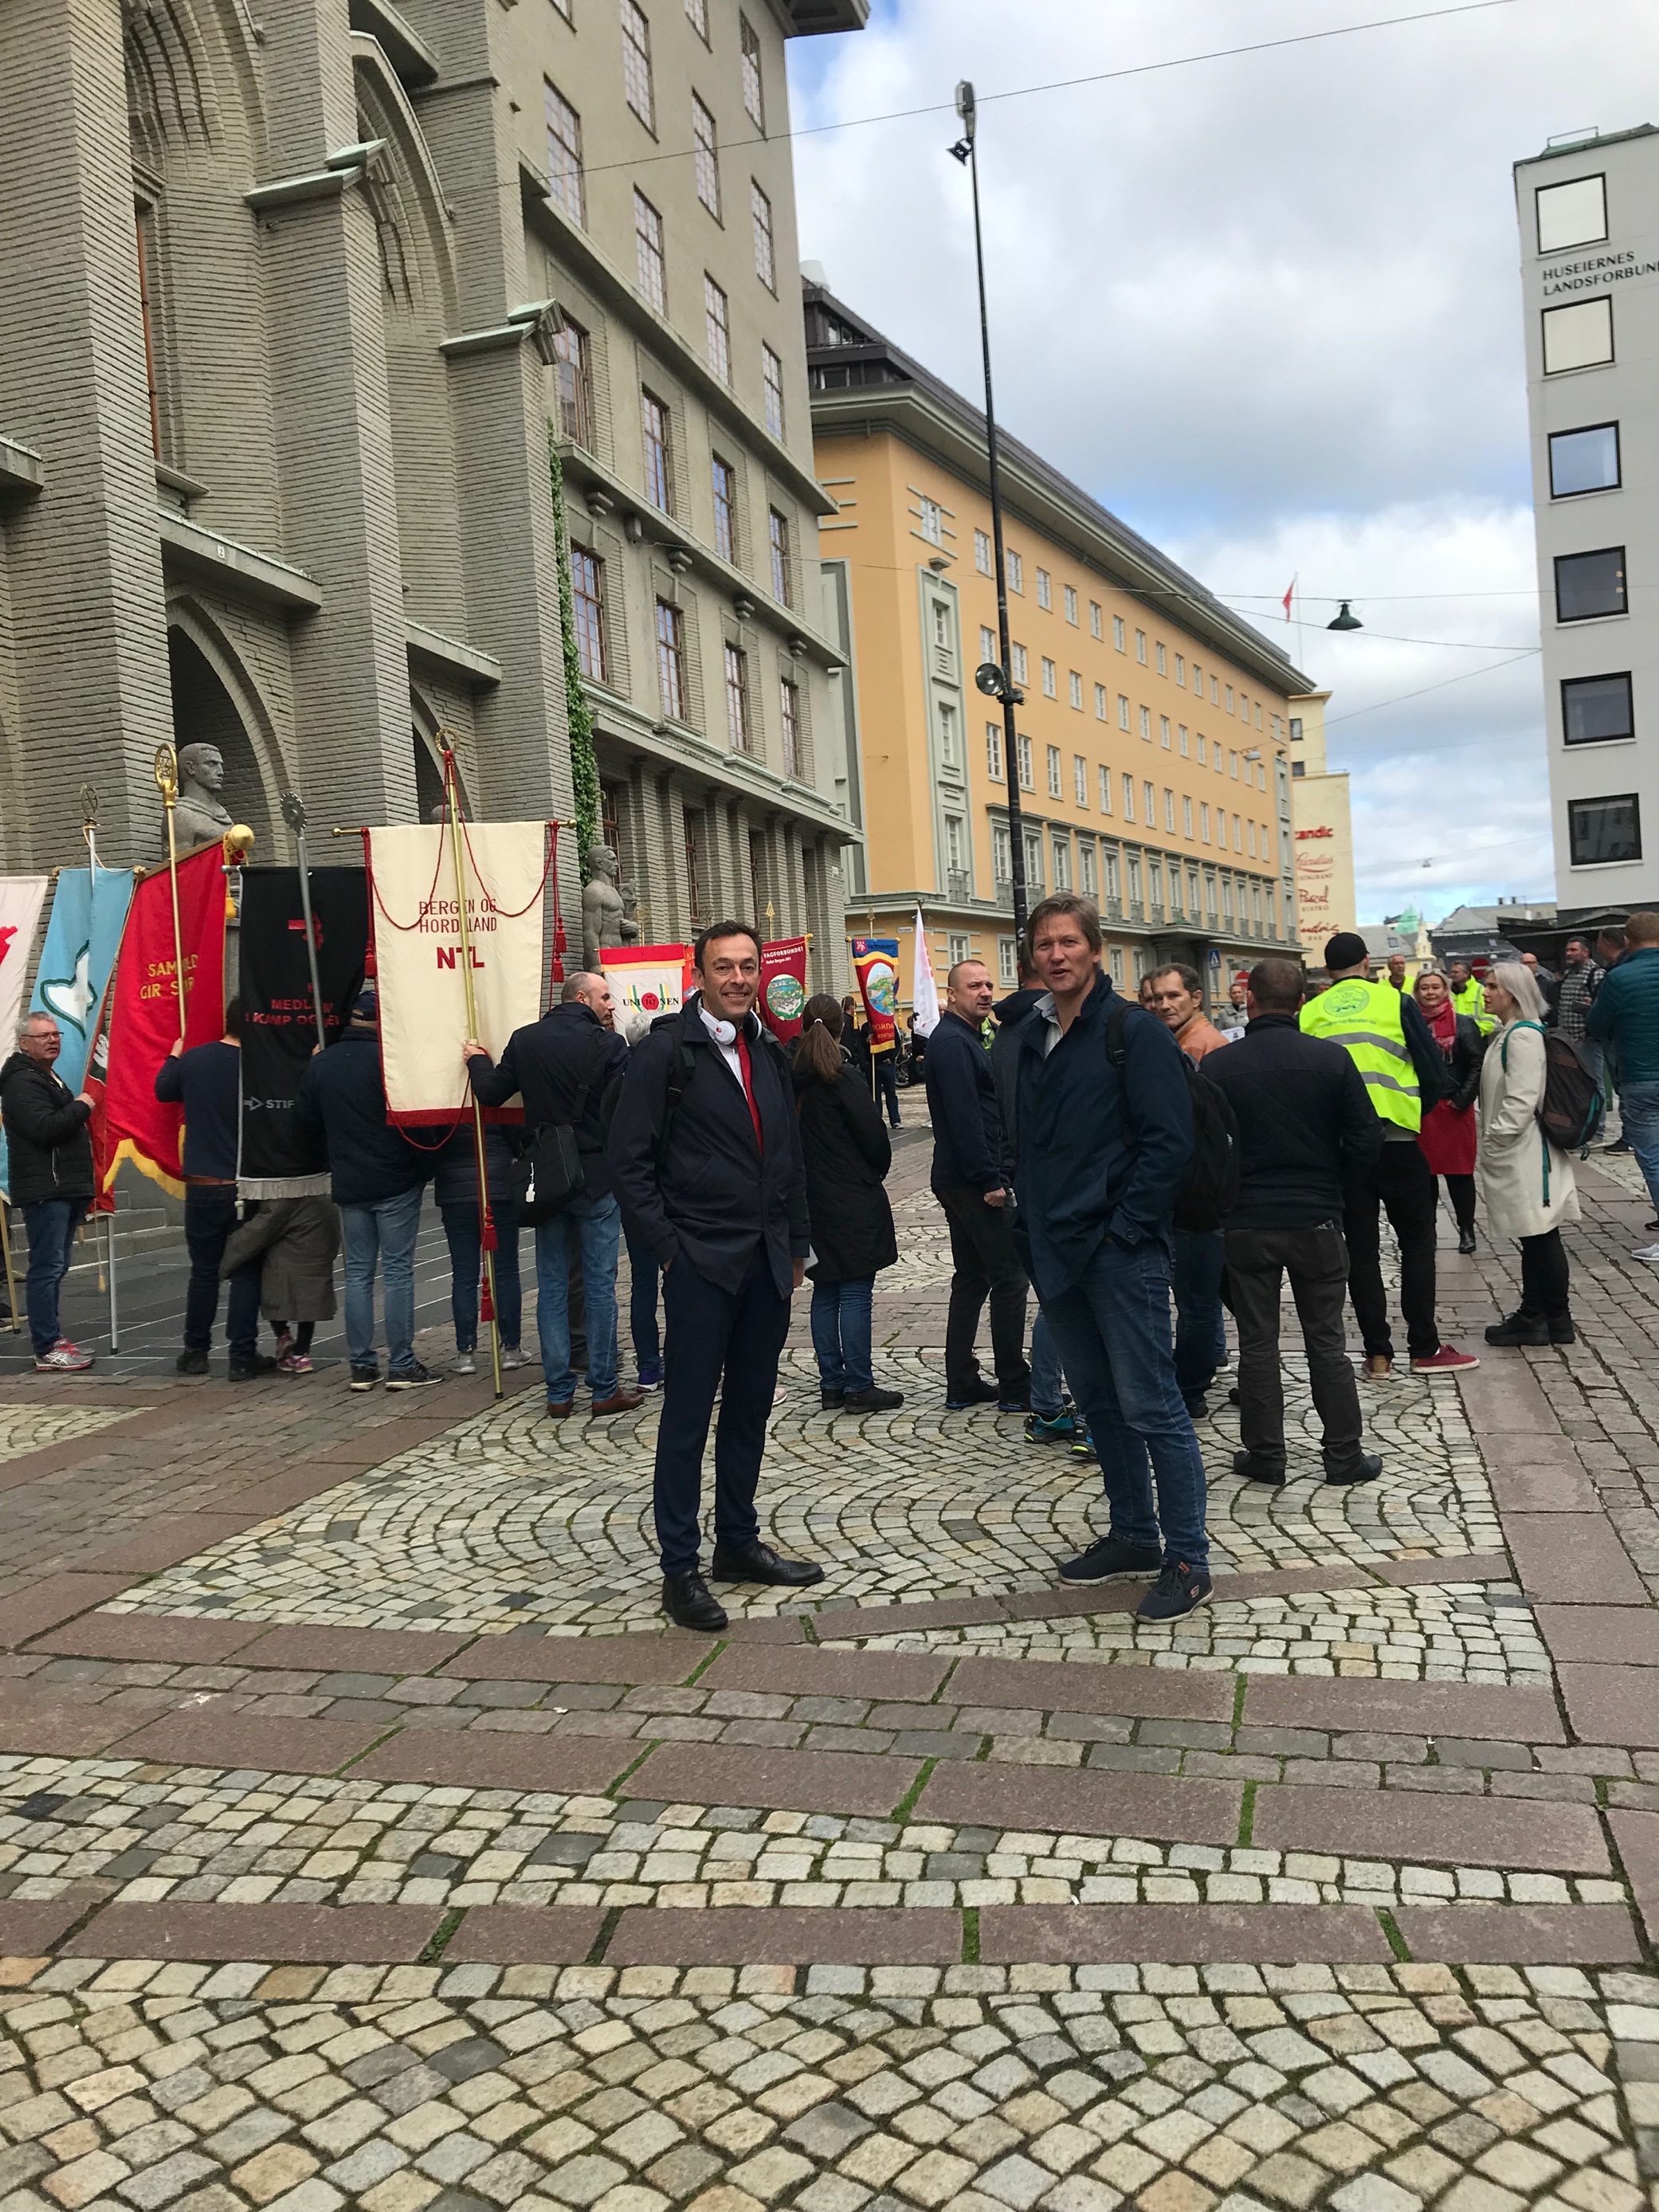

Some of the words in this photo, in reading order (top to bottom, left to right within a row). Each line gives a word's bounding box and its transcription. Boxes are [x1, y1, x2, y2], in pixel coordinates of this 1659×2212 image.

[1543, 250, 1635, 280] HUSEIERNES
[1543, 260, 1659, 296] LANDSFORBUN
[480, 898, 496, 914] OG
[419, 917, 497, 933] HORDLAND
[763, 946, 804, 959] FAGFORBUNDET
[140, 983, 162, 999] GIR
